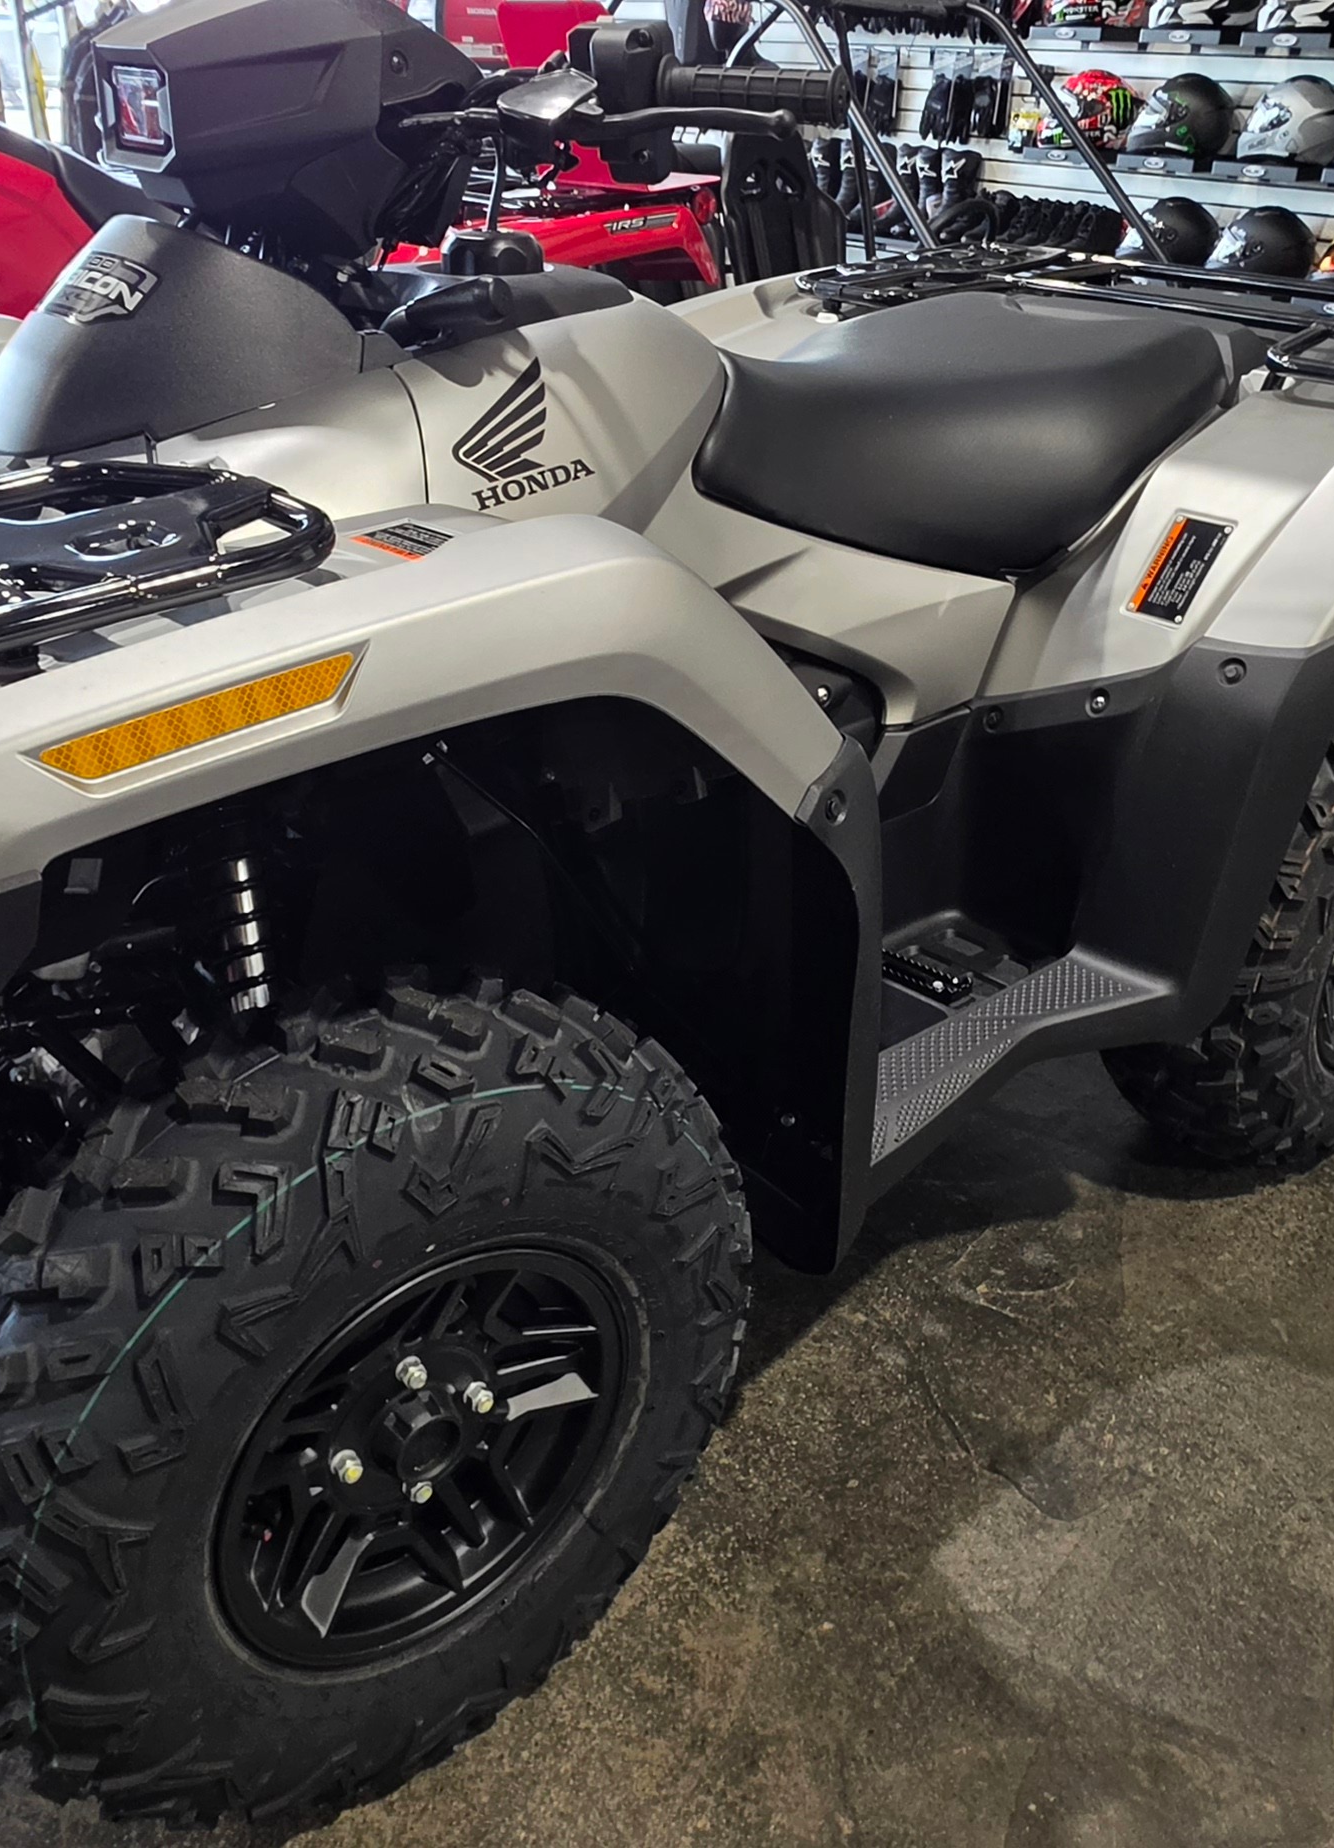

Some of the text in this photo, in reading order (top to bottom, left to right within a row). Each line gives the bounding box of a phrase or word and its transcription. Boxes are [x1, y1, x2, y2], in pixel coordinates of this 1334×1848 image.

[611, 217, 645, 232] IRS
[471, 458, 596, 511] HONDA
[1146, 536, 1174, 580] WARNING
